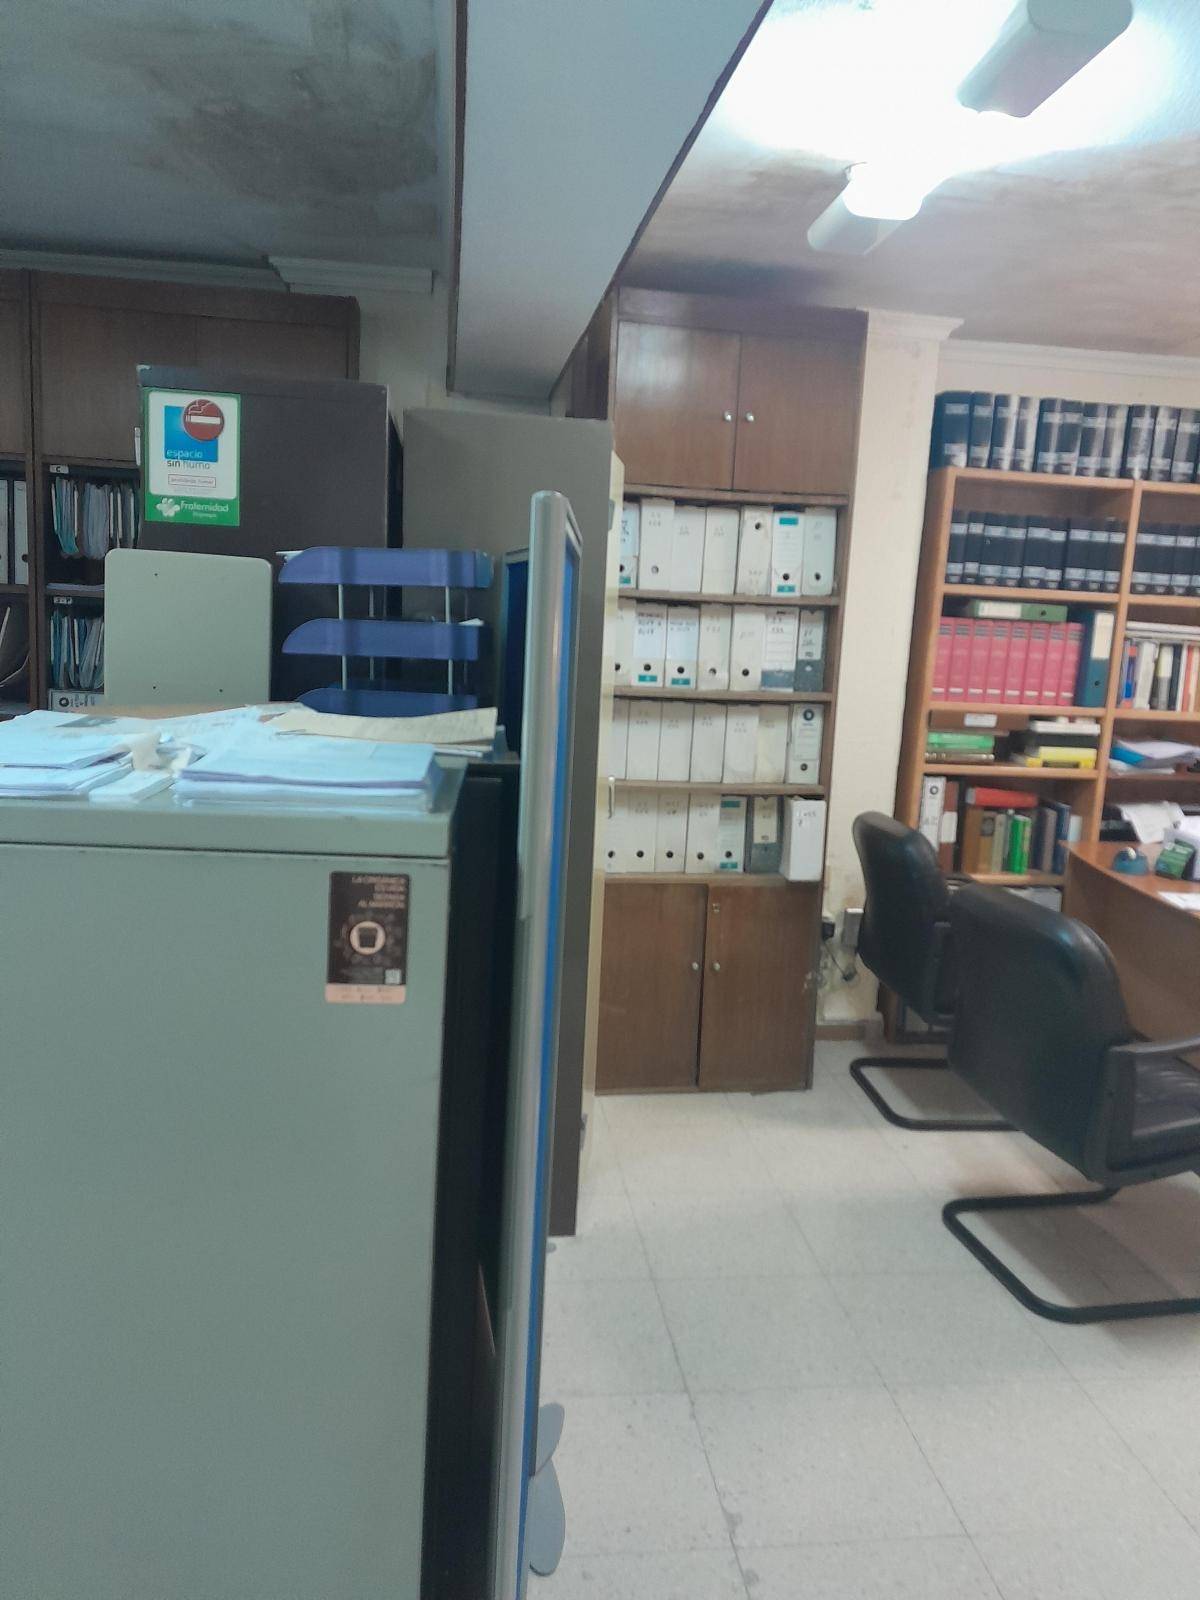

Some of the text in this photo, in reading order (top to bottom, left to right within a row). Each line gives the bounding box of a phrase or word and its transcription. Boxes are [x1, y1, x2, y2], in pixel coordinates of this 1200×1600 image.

[166, 449, 204, 459] espacio
[167, 460, 210, 470] sin humo
[181, 500, 229, 512] Fraternidad
